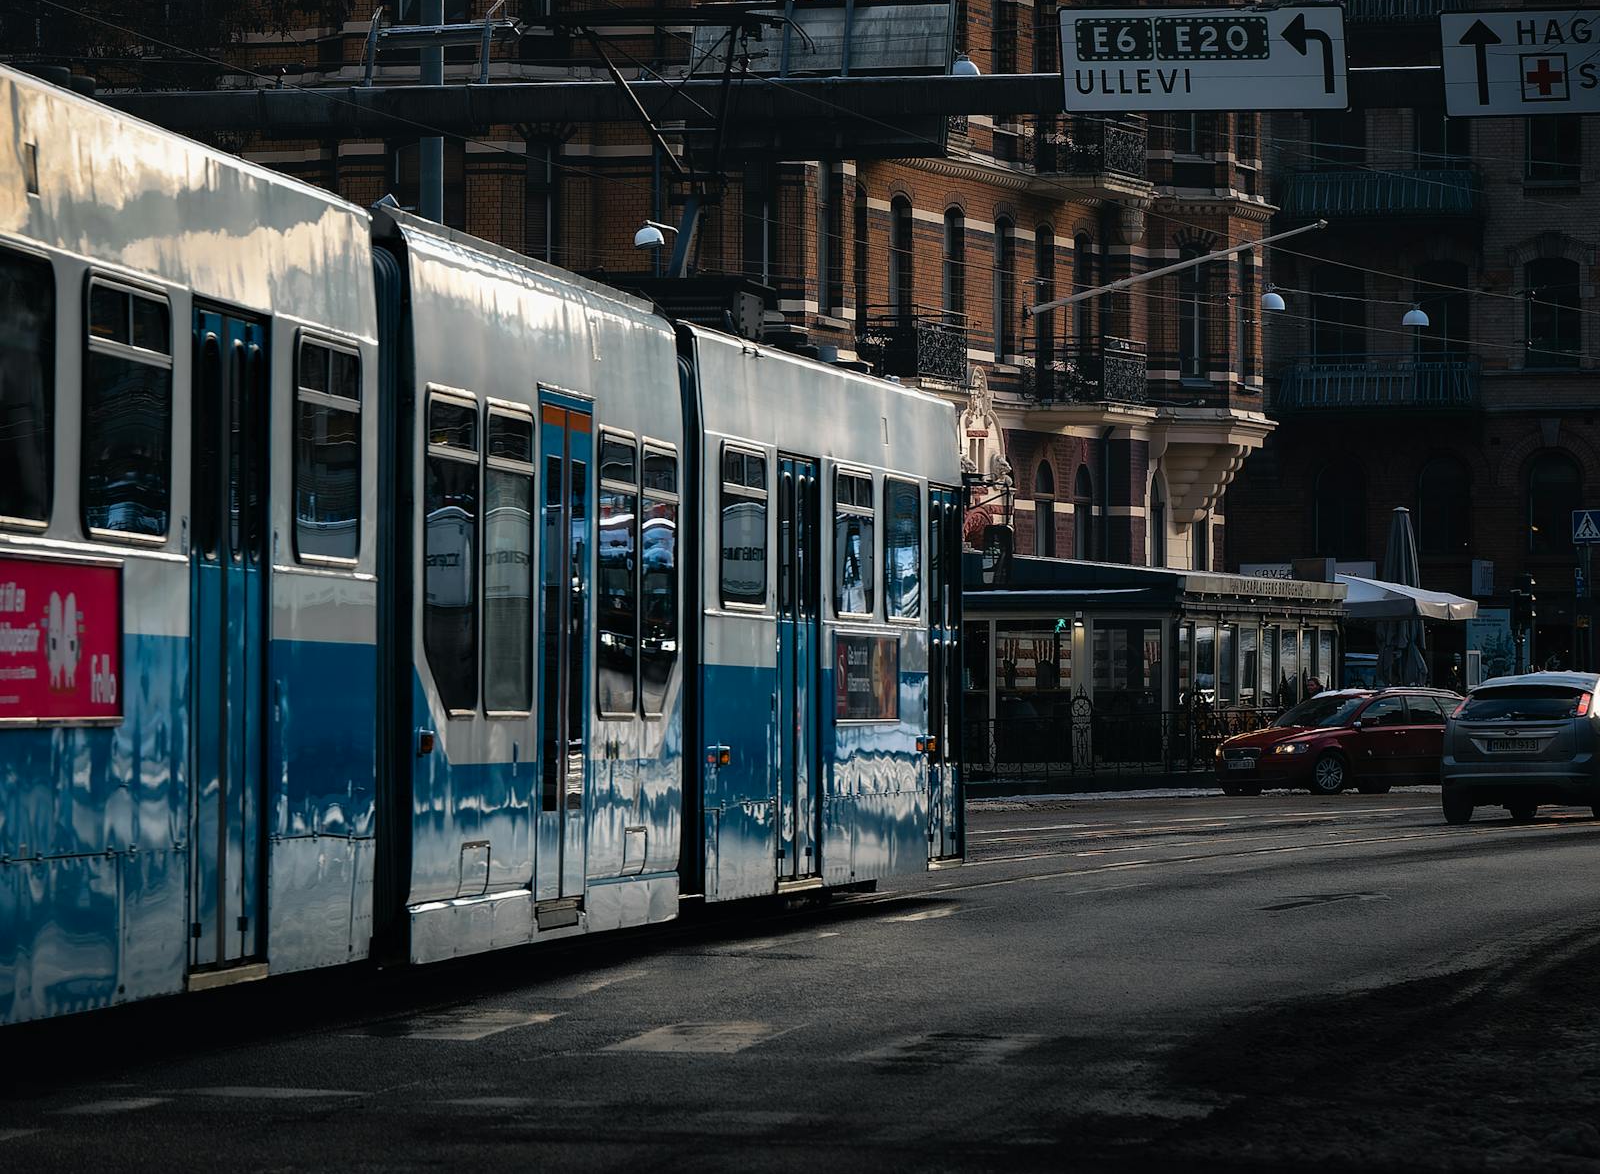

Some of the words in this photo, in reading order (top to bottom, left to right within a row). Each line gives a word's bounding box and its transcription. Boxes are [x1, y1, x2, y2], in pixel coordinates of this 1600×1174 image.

[1093, 26, 1136, 53] E6
[1176, 25, 1248, 52] E20
[1516, 18, 1600, 45] HAG
[1076, 69, 1191, 94] ULLEVI
